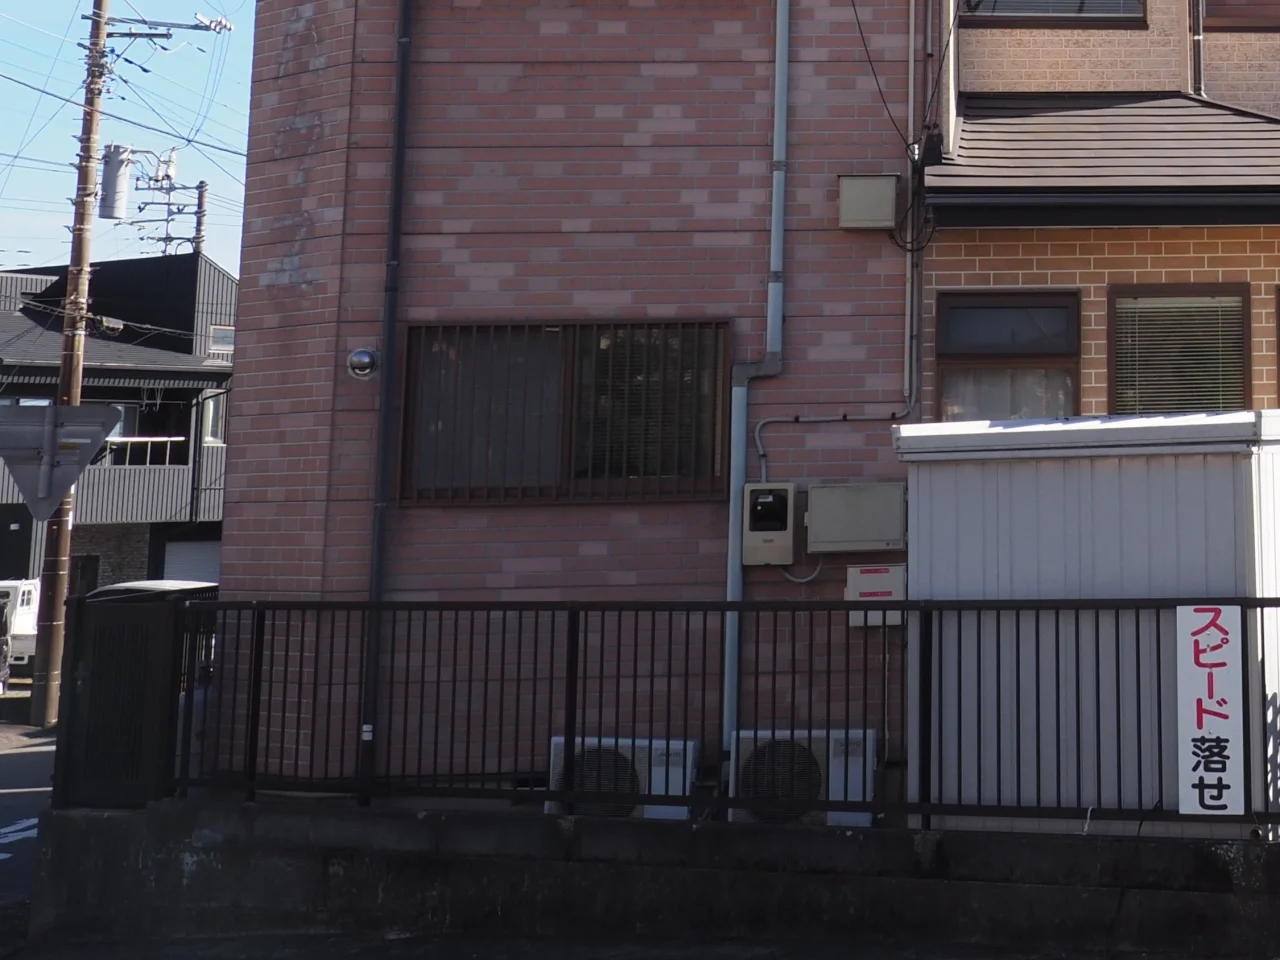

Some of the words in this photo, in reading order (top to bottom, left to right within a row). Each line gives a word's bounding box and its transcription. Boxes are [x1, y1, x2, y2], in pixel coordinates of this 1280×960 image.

[1190, 607, 1231, 811] スピード落せ
